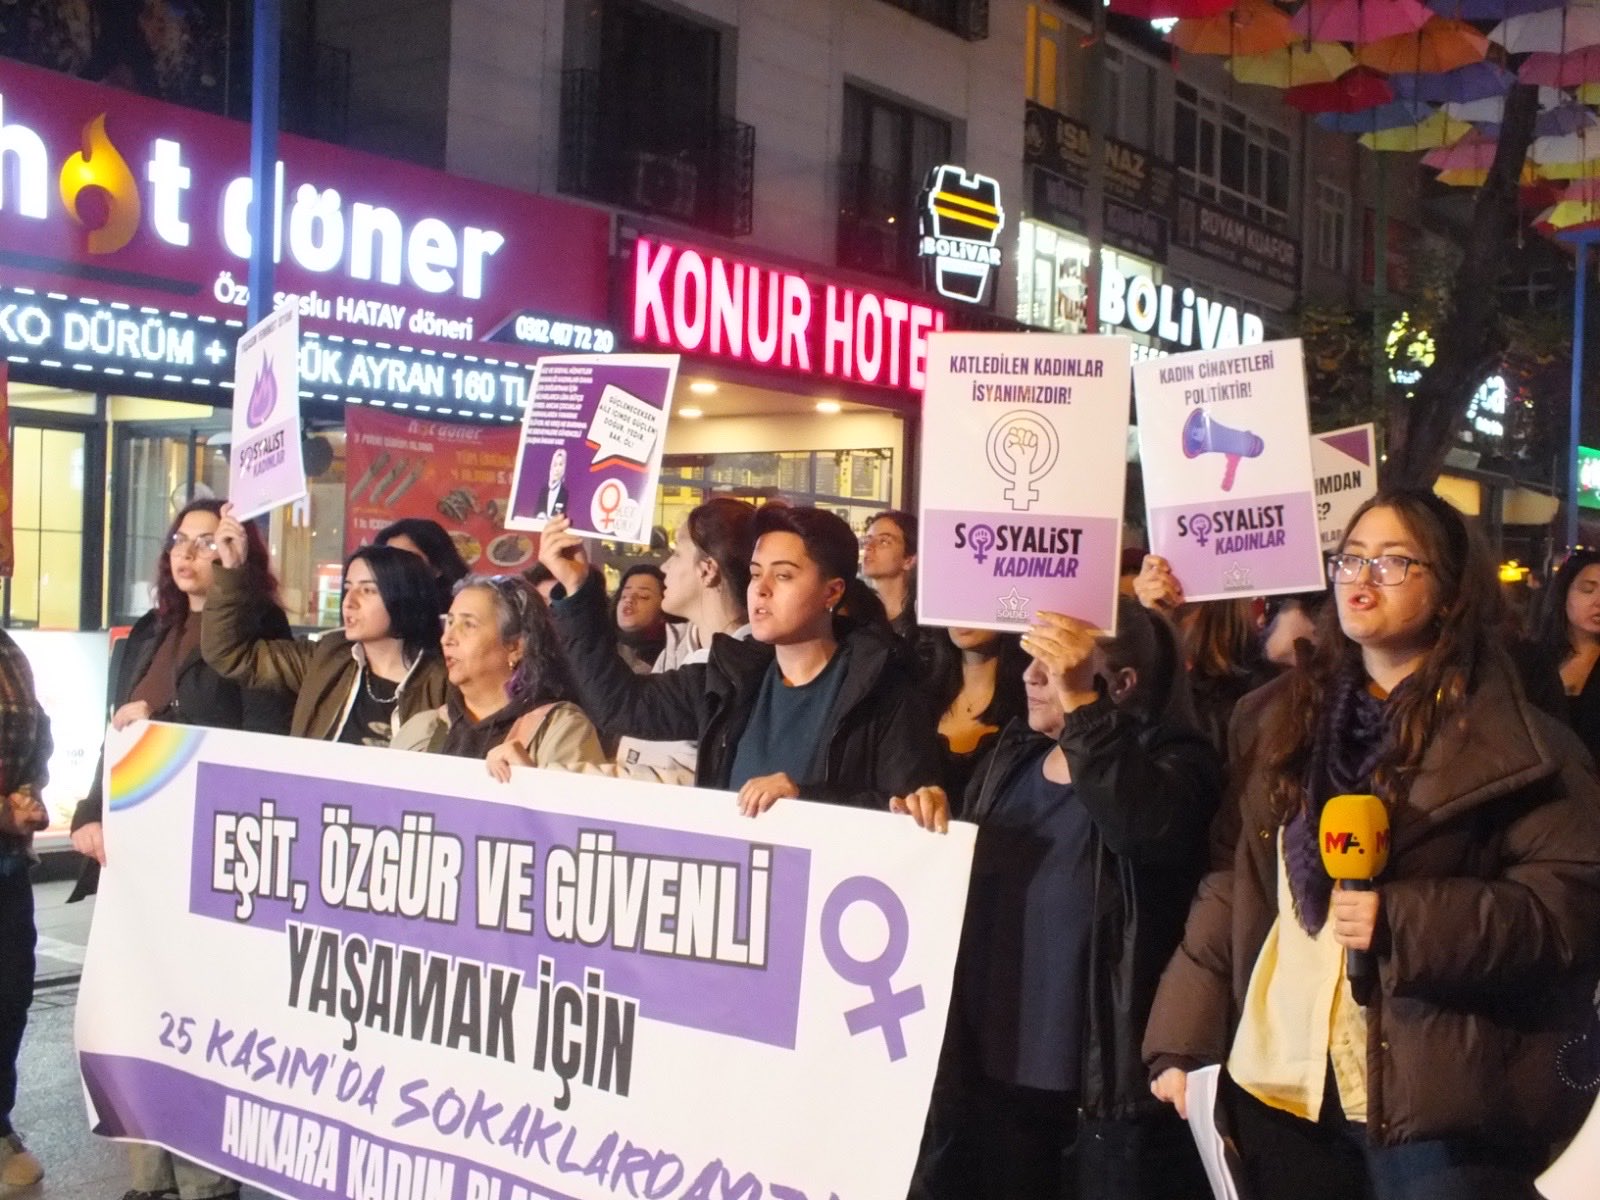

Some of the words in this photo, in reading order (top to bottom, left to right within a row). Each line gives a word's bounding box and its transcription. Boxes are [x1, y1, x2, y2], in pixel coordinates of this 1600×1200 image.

[222, 160, 505, 298] döner
[335, 295, 406, 331] HATAY
[408, 308, 474, 342] döneri
[631, 236, 812, 371] KONUR
[63, 309, 195, 366] DÜRÜM
[346, 353, 445, 397] AYRAN
[452, 367, 495, 402] 160
[499, 374, 530, 408] TL
[592, 328, 615, 353] 20
[949, 353, 1029, 376] KATLEDİLEN
[1033, 357, 1105, 378] KADINLAR
[1159, 363, 1195, 385] KADIN
[1198, 352, 1275, 380] CİNAYETLERİ
[971, 380, 1072, 405] İSYANIMIZDIR!
[1184, 379, 1253, 406] POLİTİKTİR!
[1214, 529, 1286, 556] KADINLAR
[992, 556, 1079, 579] KADINLAR
[211, 798, 309, 923] EŞİT,
[319, 803, 463, 925] ÖZGÜR
[475, 834, 537, 937] VE
[543, 828, 775, 972] GÜVENLİ
[286, 923, 522, 1063] YAŞAMAK
[532, 959, 637, 1112] İÇİN
[157, 1011, 198, 1056] 25
[204, 1018, 386, 1116] KASIM'DA
[221, 1094, 340, 1193] ANKARA
[346, 1134, 456, 1200] KADIN
